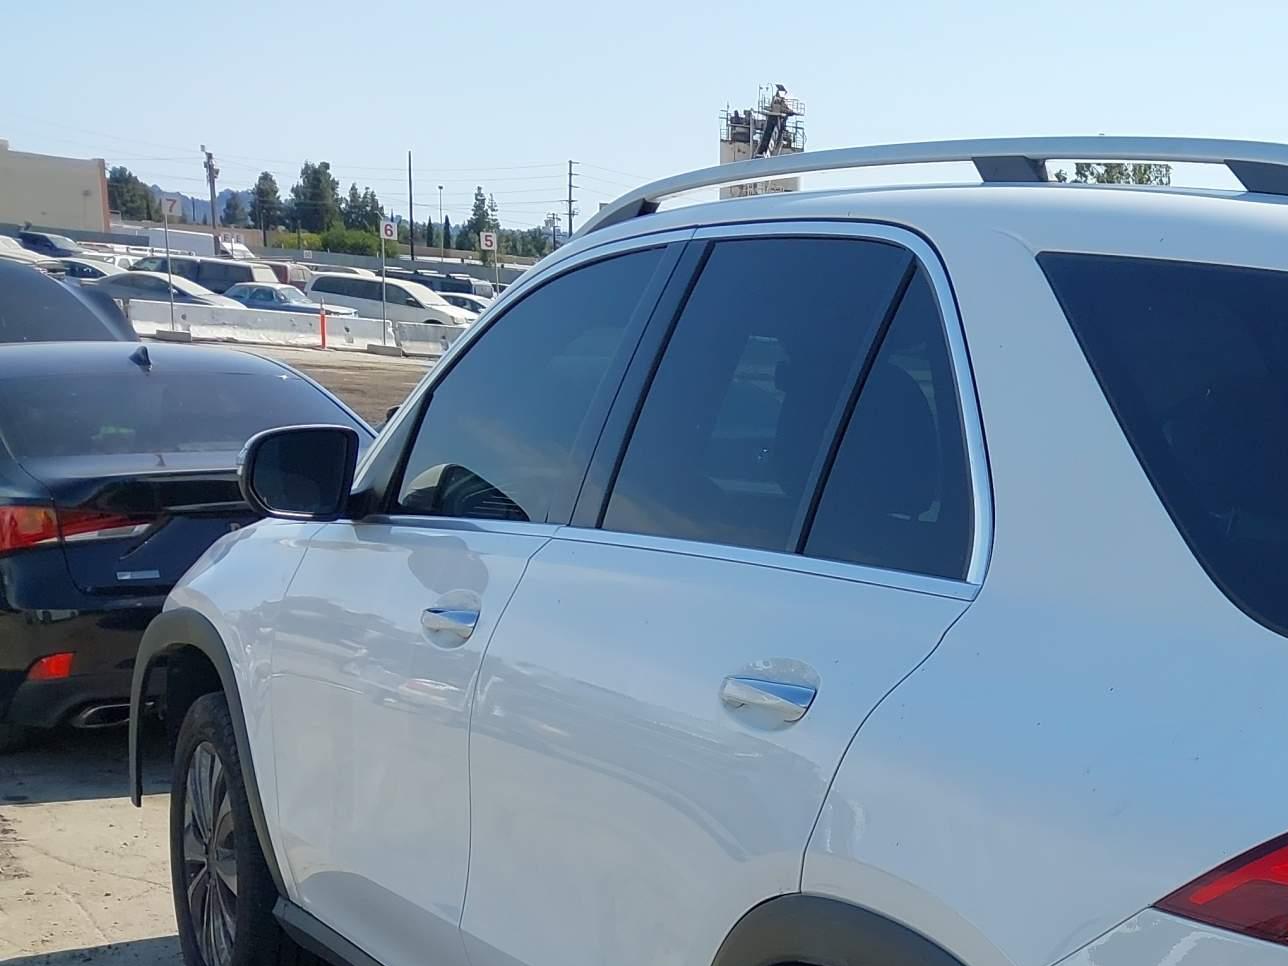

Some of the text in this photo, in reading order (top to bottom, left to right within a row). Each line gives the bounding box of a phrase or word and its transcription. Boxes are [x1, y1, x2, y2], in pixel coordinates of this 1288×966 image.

[165, 198, 177, 213] 7
[384, 223, 394, 238] 6
[484, 234, 495, 248] 5
